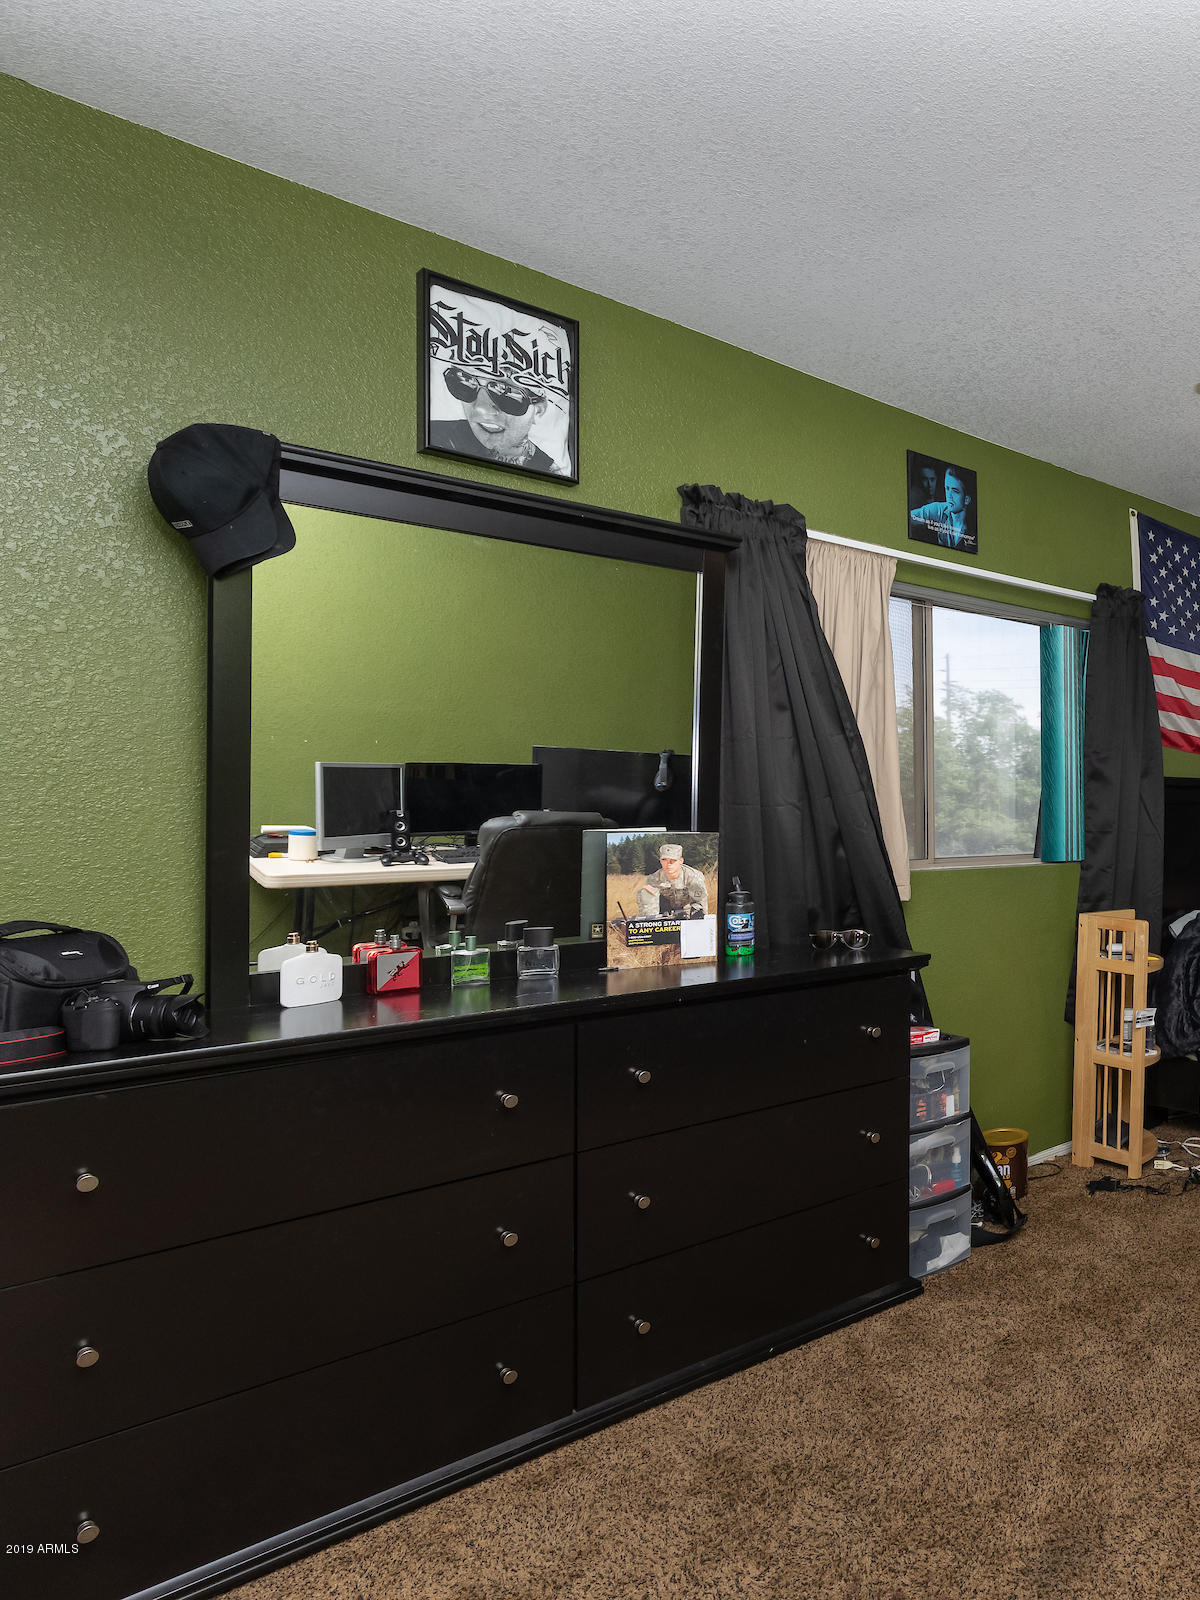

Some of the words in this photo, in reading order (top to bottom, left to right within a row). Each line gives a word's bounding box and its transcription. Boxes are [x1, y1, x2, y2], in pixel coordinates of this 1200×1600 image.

[430, 301, 499, 374] Stay
[500, 328, 571, 385] Sick
[296, 972, 336, 985] GOLD
